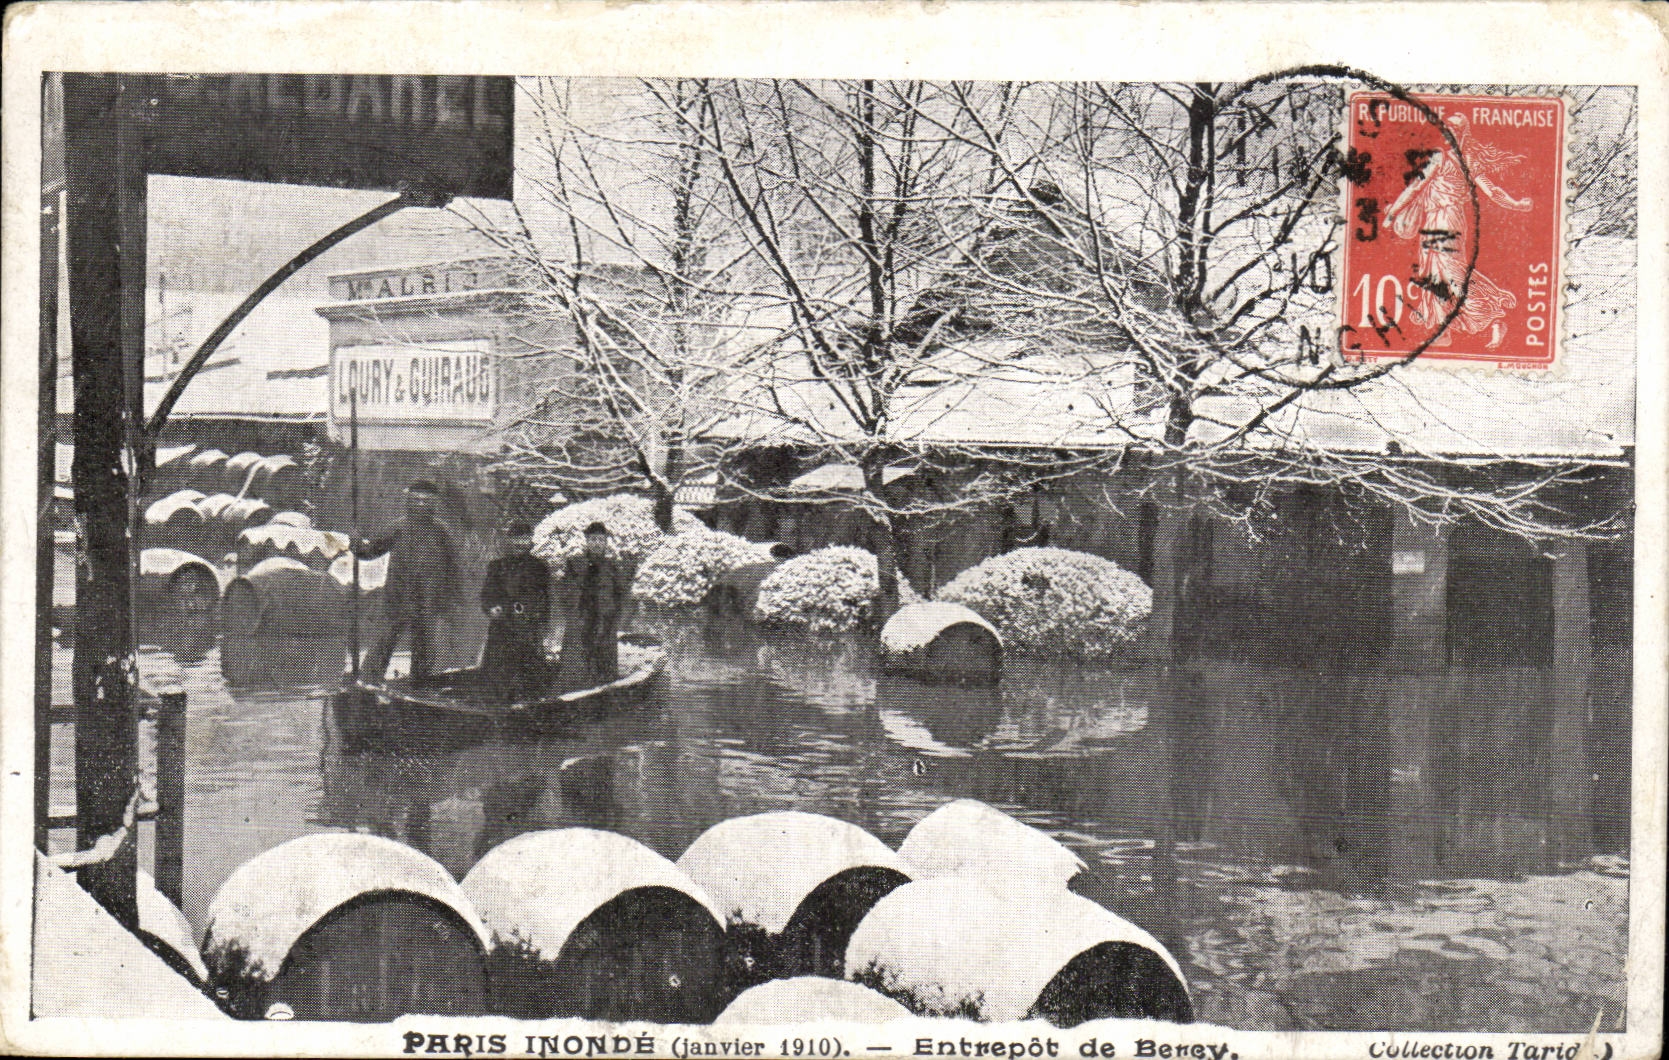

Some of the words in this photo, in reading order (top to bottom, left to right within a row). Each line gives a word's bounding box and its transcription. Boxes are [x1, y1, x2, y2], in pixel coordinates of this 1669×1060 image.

[1358, 102, 1445, 125] RPUBLIQUE
[1472, 107, 1554, 127] FRANÇAISE
[1525, 262, 1549, 347] POSTES
